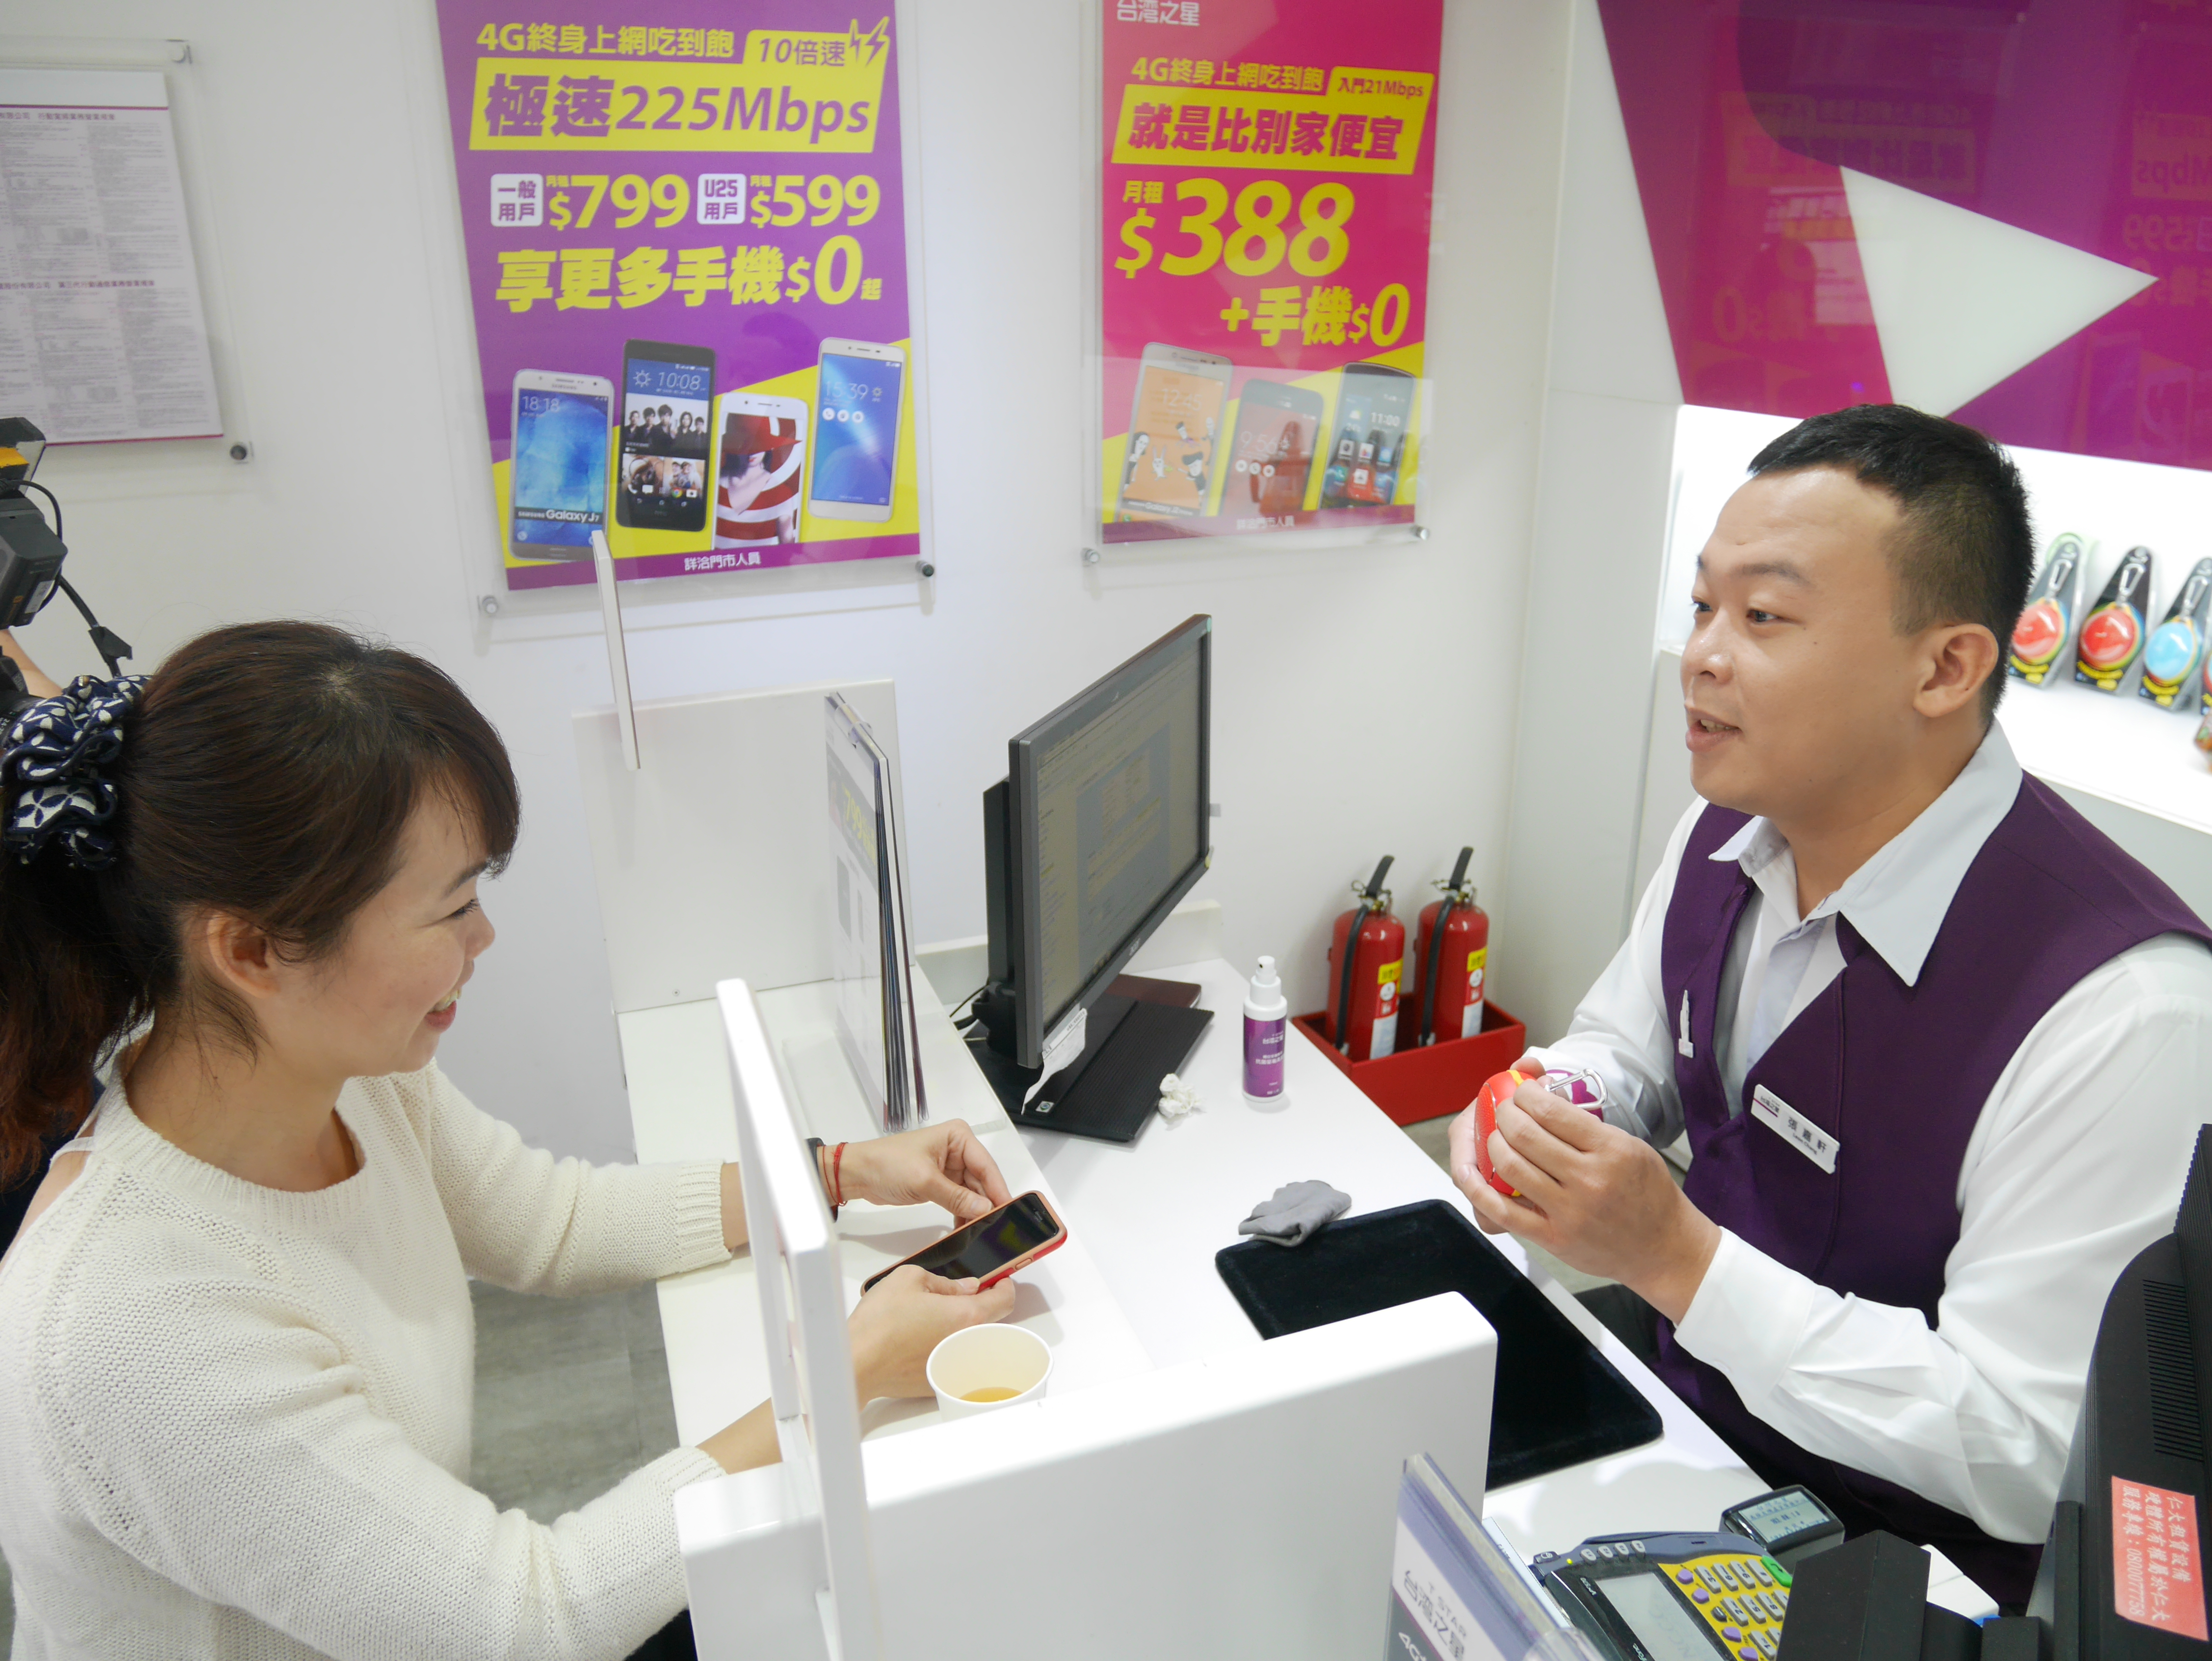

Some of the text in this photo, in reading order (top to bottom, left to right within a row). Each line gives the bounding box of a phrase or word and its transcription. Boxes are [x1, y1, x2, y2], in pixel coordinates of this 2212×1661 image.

[1117, 0, 1200, 26] 台灣之星
[476, 23, 735, 57] 4G終身上網吃到飽
[759, 37, 846, 67] 10倍速
[1131, 57, 1324, 92] 4G終身上網吃到飽
[1337, 77, 1424, 98] 入門21Mbps
[484, 73, 870, 145] 極速225Mbps
[1128, 102, 1404, 160] 就是比別家便宜
[497, 180, 536, 199] 一般
[704, 179, 738, 198] U25
[750, 174, 881, 229] $599
[1123, 181, 1163, 204] 月租
[497, 203, 535, 222] 用戶
[548, 174, 691, 231] $799
[704, 202, 738, 220] 用戶
[1114, 177, 1355, 278] $388
[658, 371, 702, 391] 10:08
[546, 508, 588, 524] Galaxy
[588, 512, 600, 522] J7
[684, 552, 761, 572] 詳洽門市人員
[2166, 1496, 2191, 1583] 仁大租賃設備
